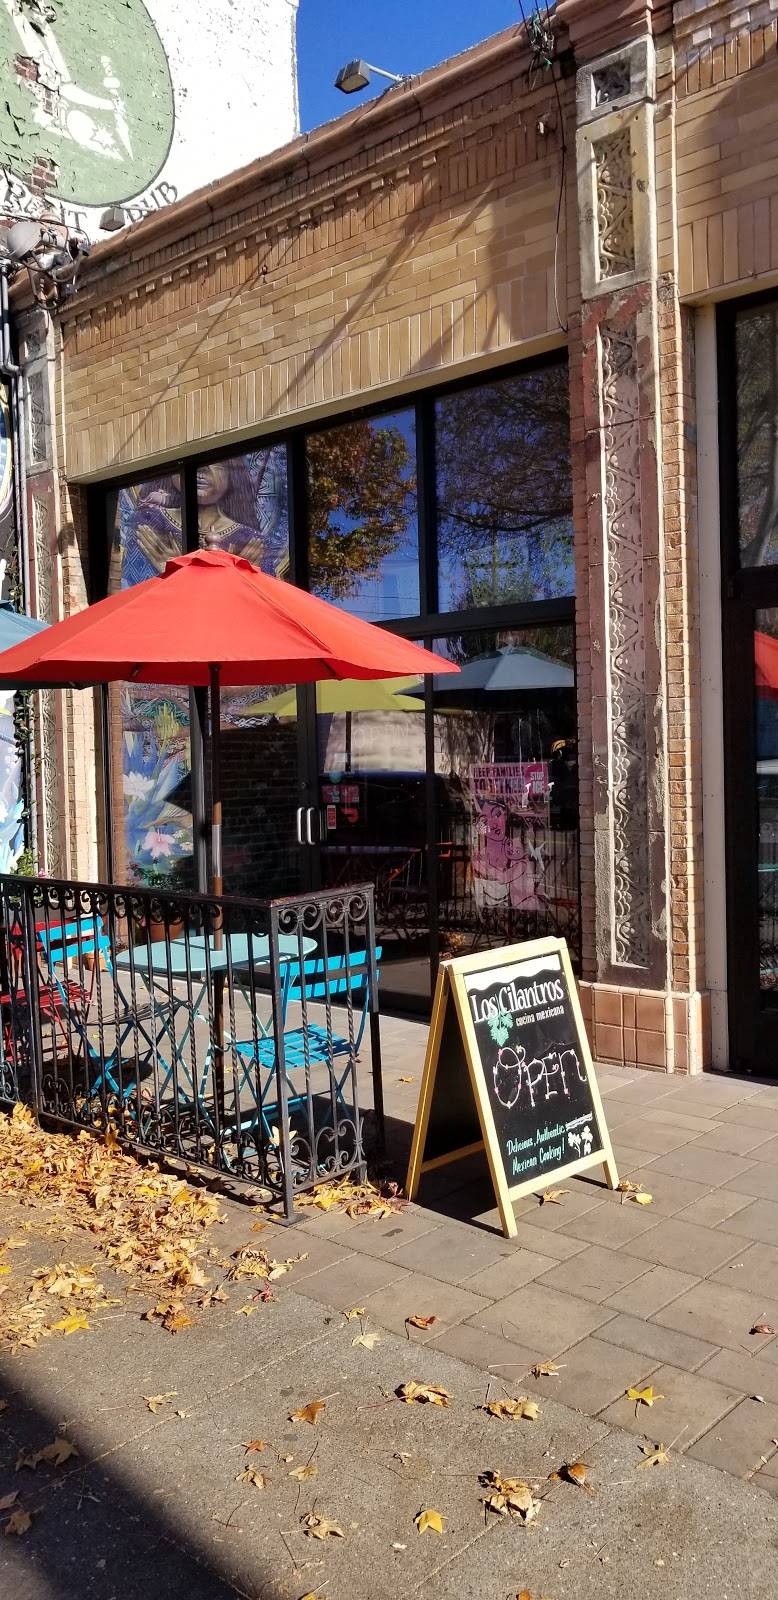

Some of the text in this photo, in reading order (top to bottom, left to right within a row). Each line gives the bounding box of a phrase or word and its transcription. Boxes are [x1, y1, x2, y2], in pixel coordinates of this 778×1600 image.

[470, 978, 564, 1024] Los Cilantros
[516, 1005, 565, 1026] cocina mexicana
[512, 1156, 538, 1175] Mexican
